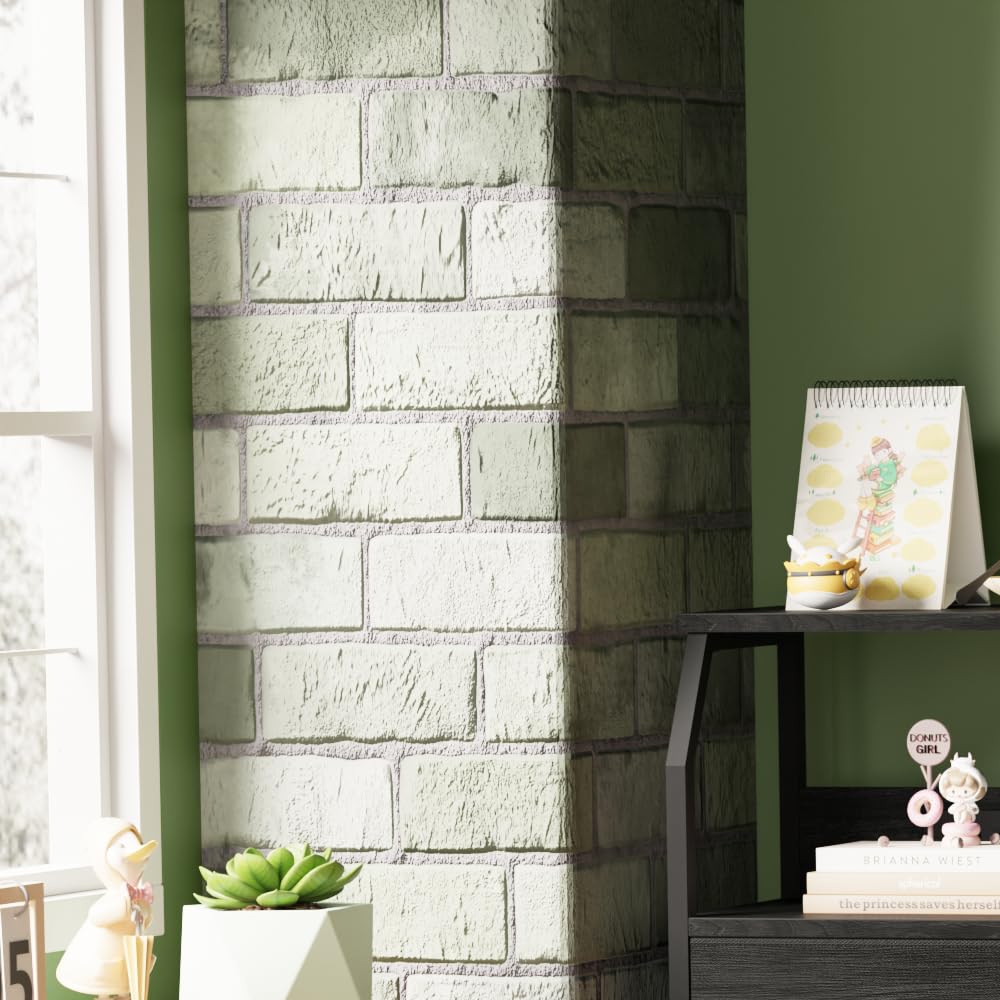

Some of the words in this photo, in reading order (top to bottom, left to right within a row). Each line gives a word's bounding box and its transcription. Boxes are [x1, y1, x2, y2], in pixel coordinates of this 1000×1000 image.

[909, 733, 949, 743] DONUTS
[916, 744, 942, 755] GIRL
[863, 855, 931, 866] BRIANNA
[938, 855, 983, 867] WIEST
[839, 898, 861, 909] the
[862, 899, 919, 911] princess
[920, 901, 956, 910] saves
